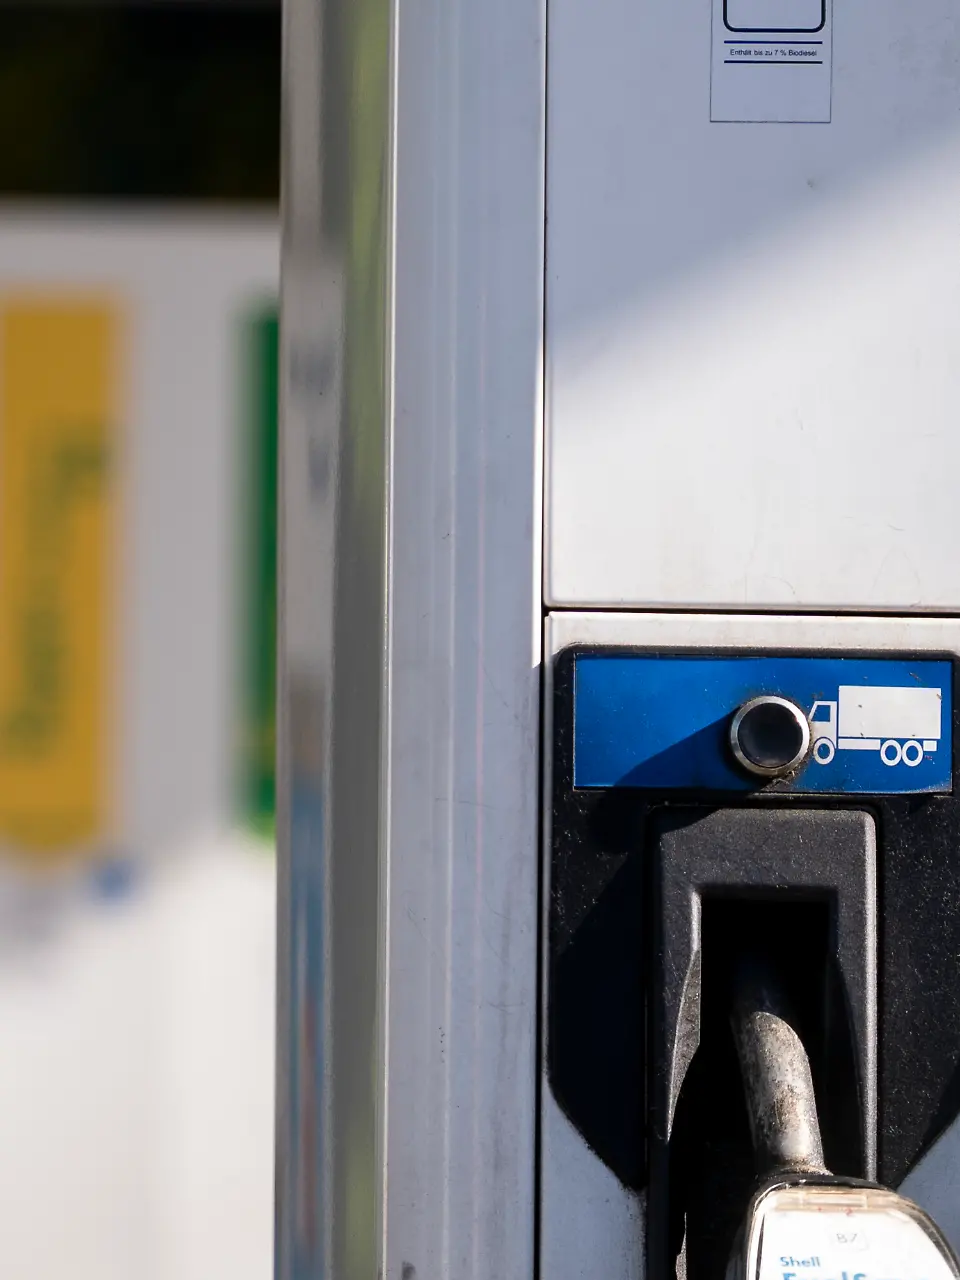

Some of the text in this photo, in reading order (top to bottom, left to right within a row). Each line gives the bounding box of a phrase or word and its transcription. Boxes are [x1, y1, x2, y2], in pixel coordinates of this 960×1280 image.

[780, 49, 787, 57] %
[788, 49, 817, 57] Biodiesel
[836, 1232, 858, 1244] B7
[779, 1256, 821, 1268] Shell
